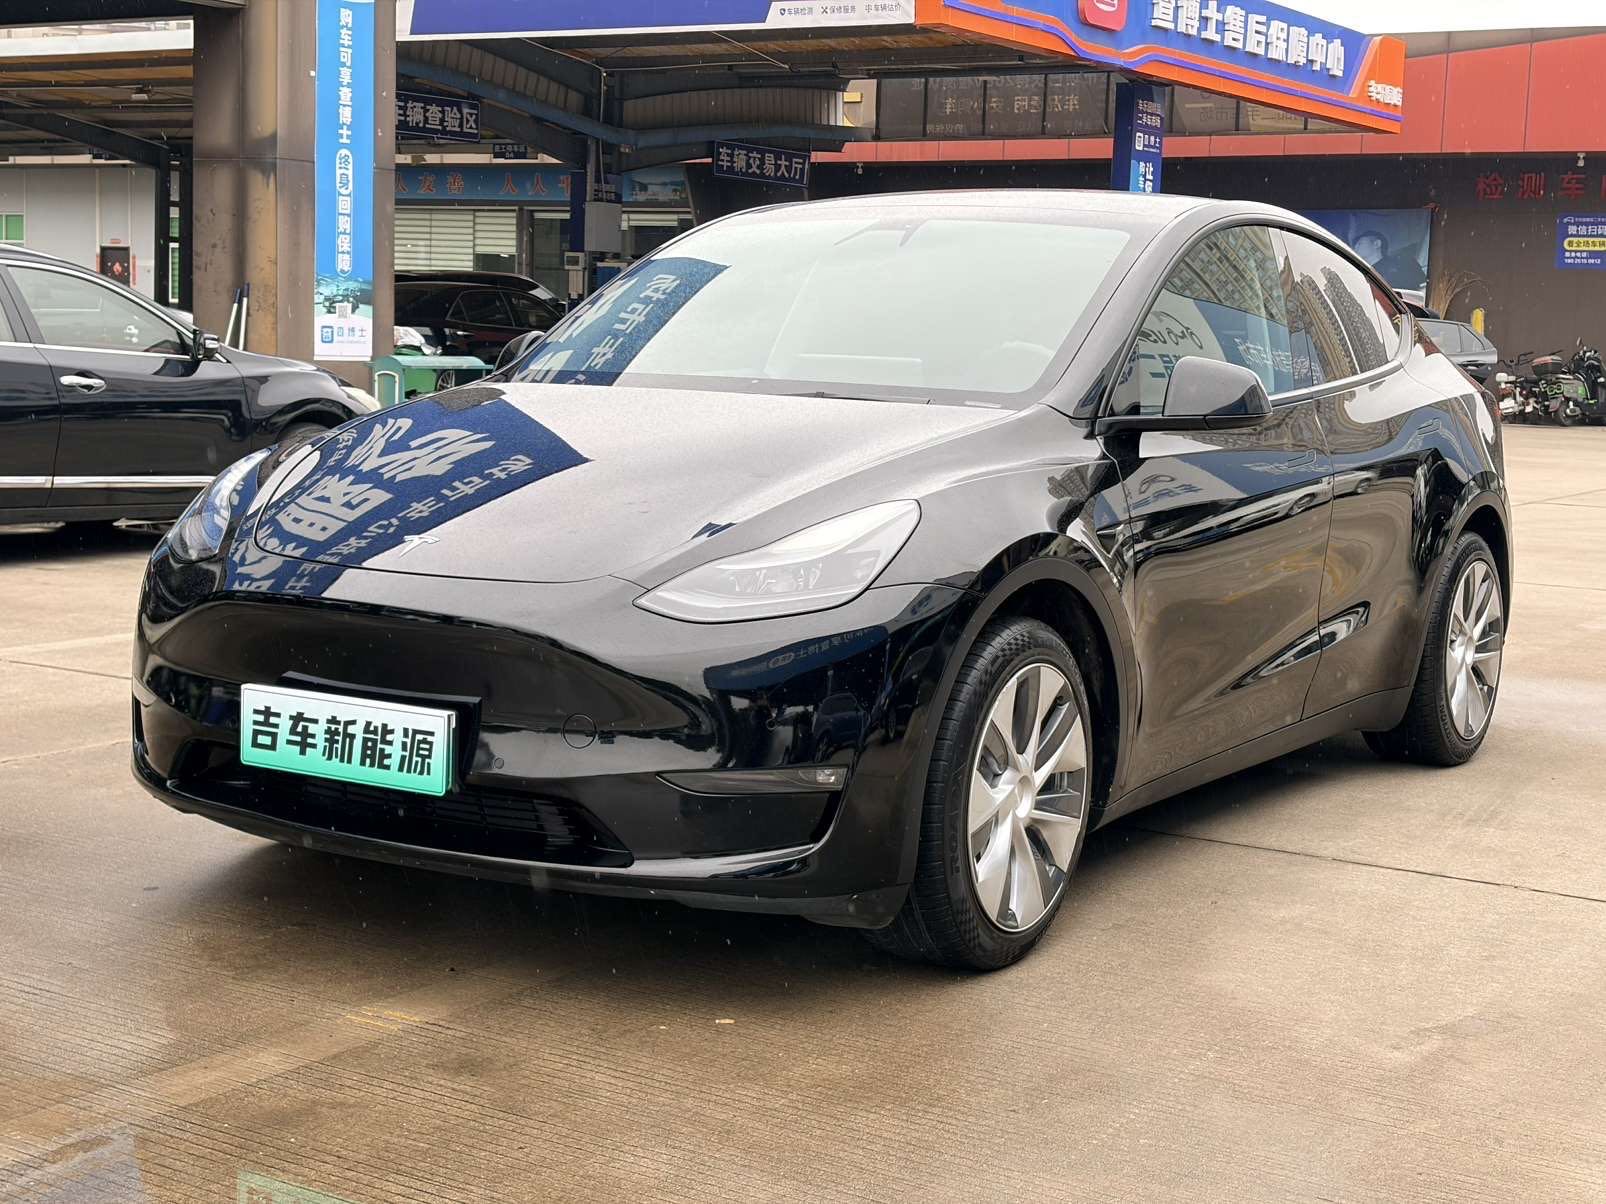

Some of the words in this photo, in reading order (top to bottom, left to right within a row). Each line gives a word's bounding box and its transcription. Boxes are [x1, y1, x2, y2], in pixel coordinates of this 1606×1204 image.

[787, 7, 814, 16] 车辆检测
[829, 5, 856, 14] 保修服务
[873, 3, 900, 12] 车辆估价
[1151, 0, 1345, 77] 查博士售后保障中心
[338, 8, 353, 144] 购车可享查博士
[718, 146, 804, 179] 车辆交易大厅
[1476, 170, 1606, 200] 检测车
[337, 153, 352, 273] 终身回购保障
[251, 705, 436, 777] 吉车新能源
